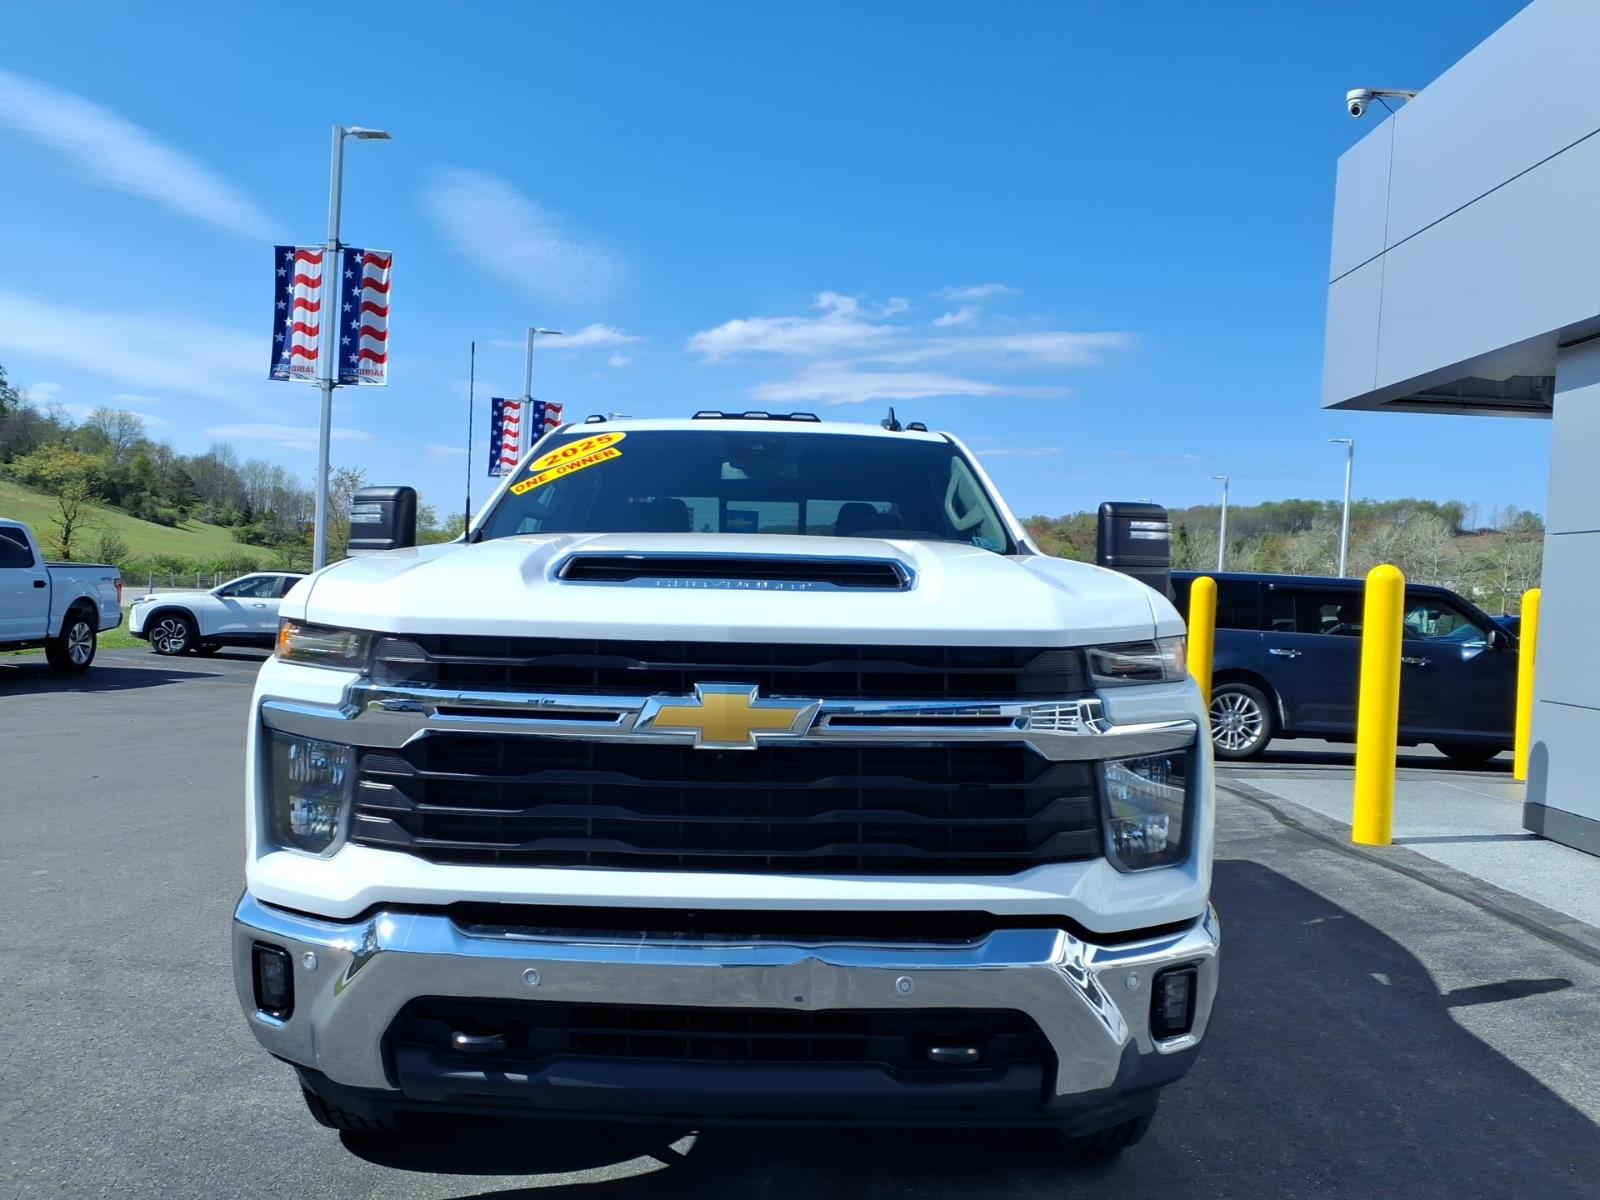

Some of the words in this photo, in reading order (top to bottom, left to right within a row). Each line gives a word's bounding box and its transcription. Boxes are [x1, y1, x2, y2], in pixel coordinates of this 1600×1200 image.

[544, 434, 613, 467] 2025
[515, 473, 549, 493] ONE
[556, 449, 616, 474] OWNER
